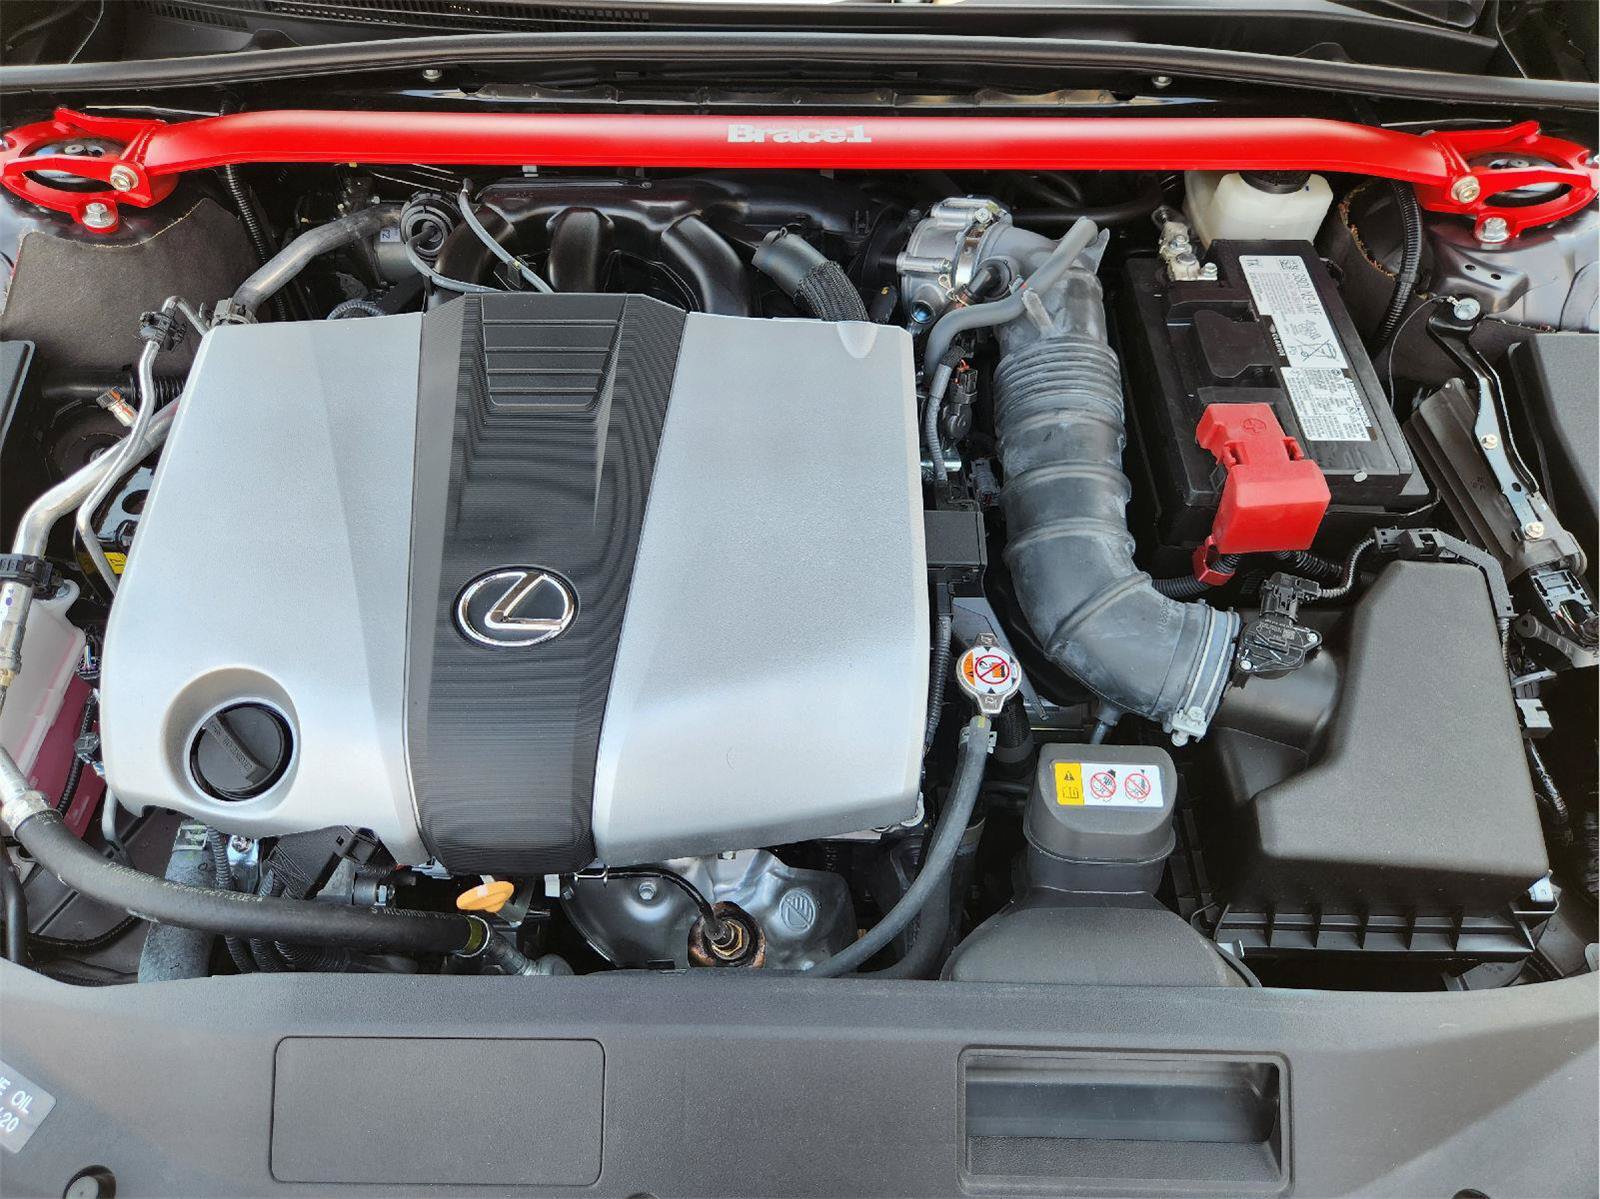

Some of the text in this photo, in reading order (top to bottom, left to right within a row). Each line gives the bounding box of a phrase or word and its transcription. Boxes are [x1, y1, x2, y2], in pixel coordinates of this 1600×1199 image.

[727, 124, 872, 143] Brace1
[0, 1076, 33, 1115] E OIL
[0, 1107, 20, 1132] 20
